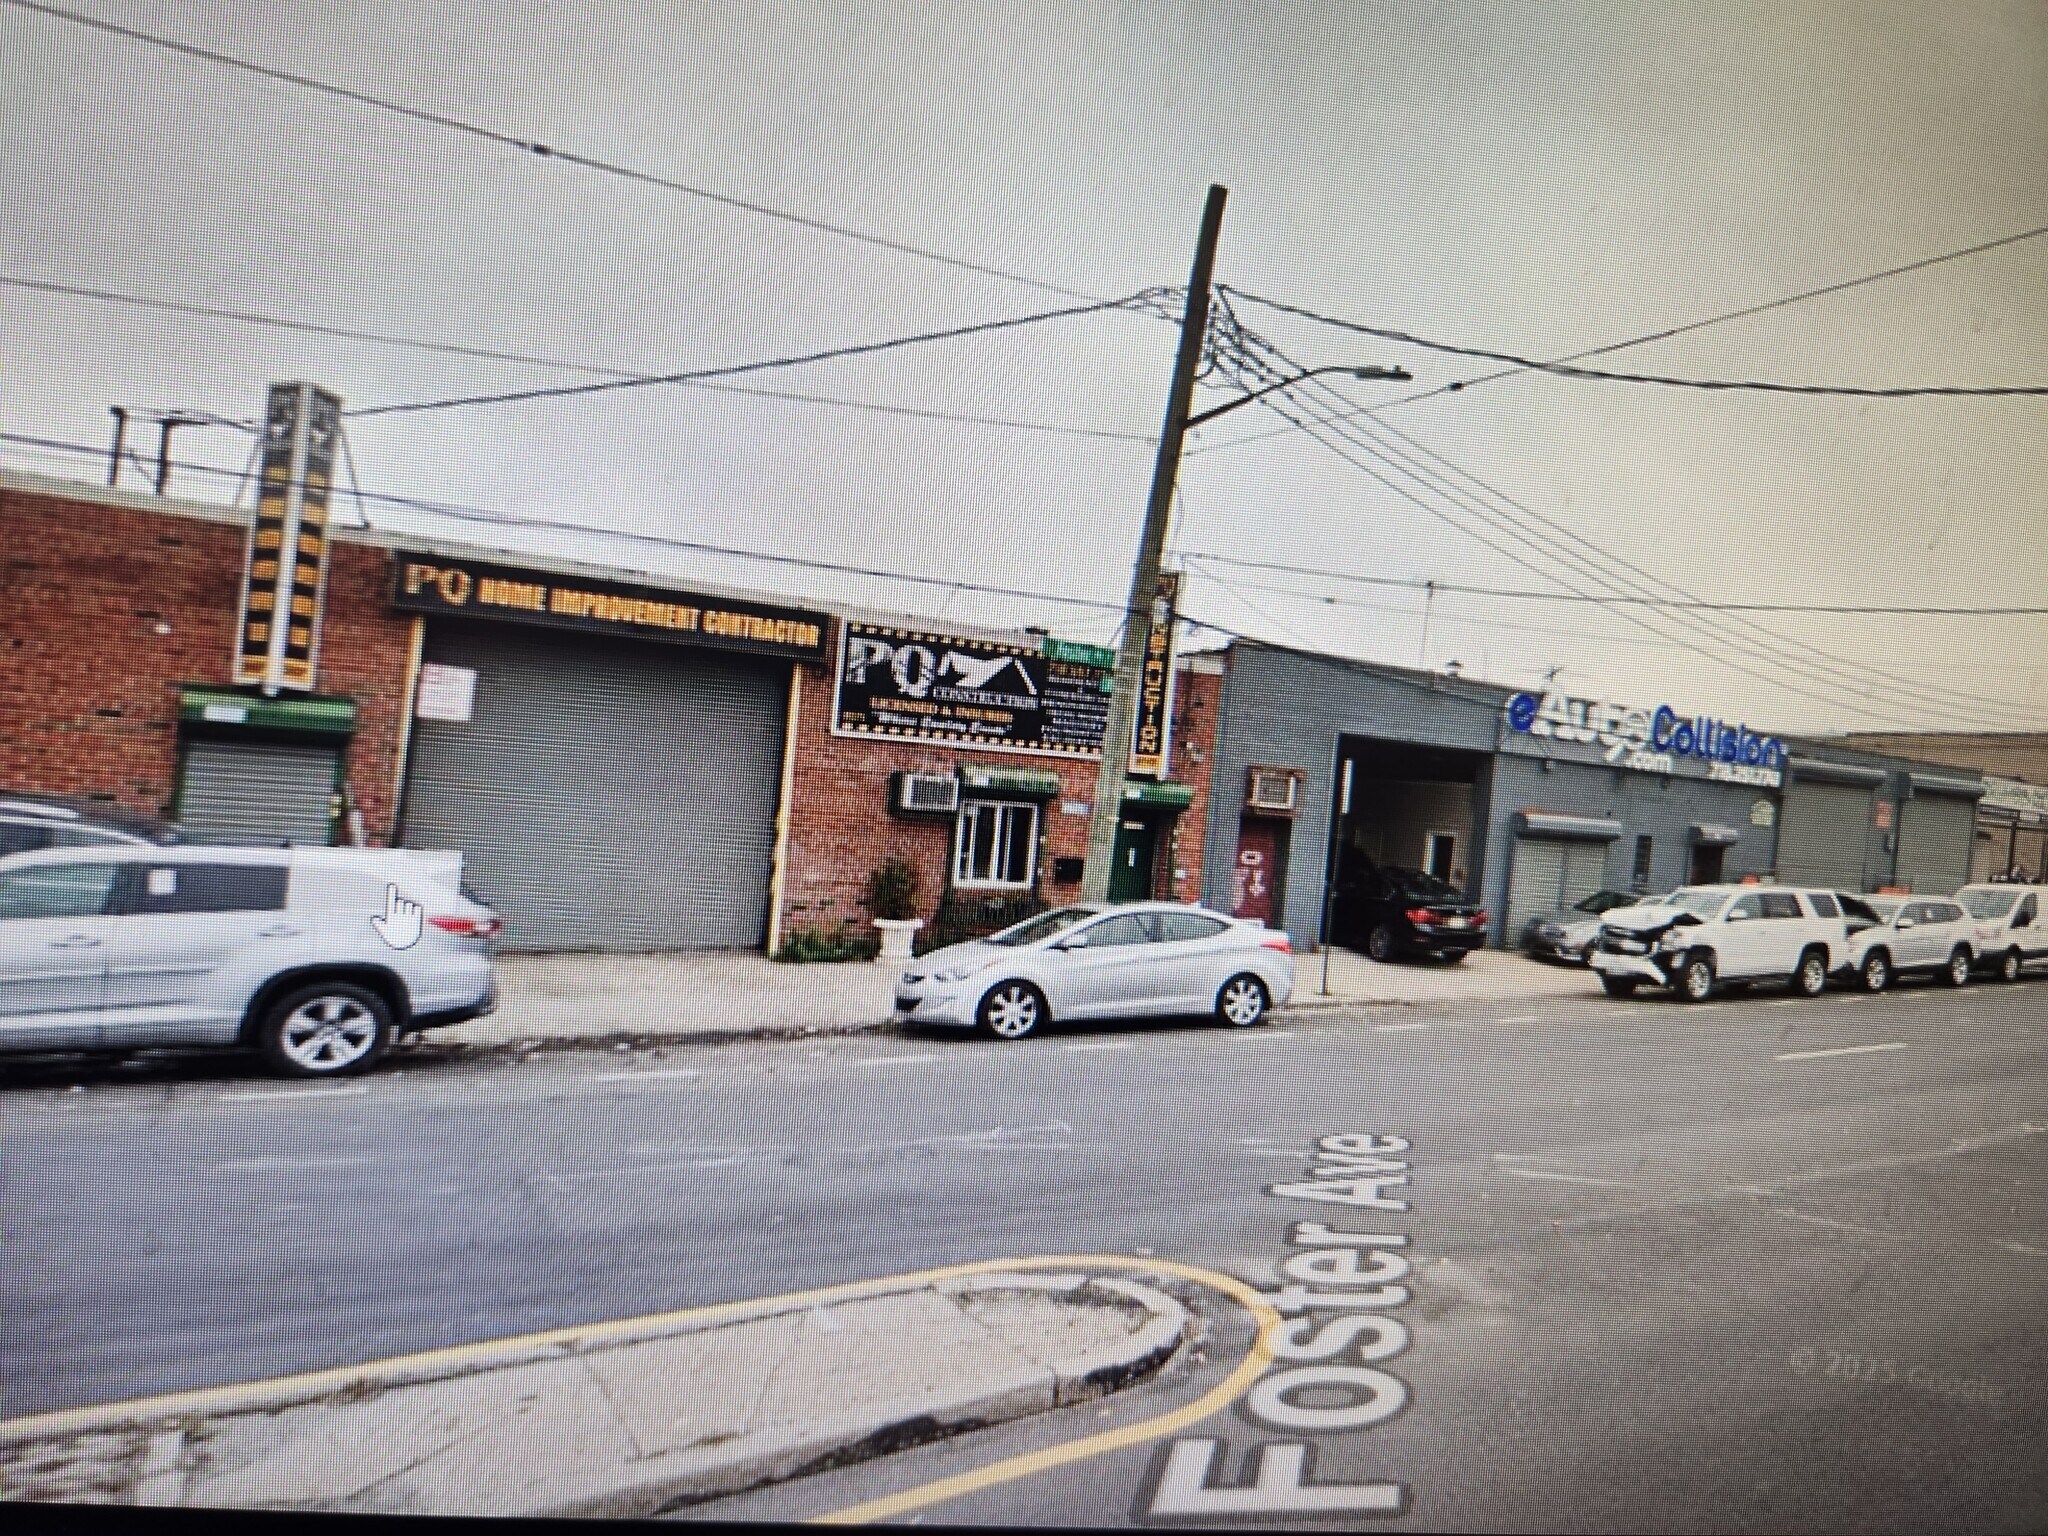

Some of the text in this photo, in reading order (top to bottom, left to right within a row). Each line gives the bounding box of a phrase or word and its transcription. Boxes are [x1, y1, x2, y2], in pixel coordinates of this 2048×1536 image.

[406, 563, 820, 649] PQ HOME IMPROVEMENT CONTRACTOR
[845, 636, 937, 699] PQ
